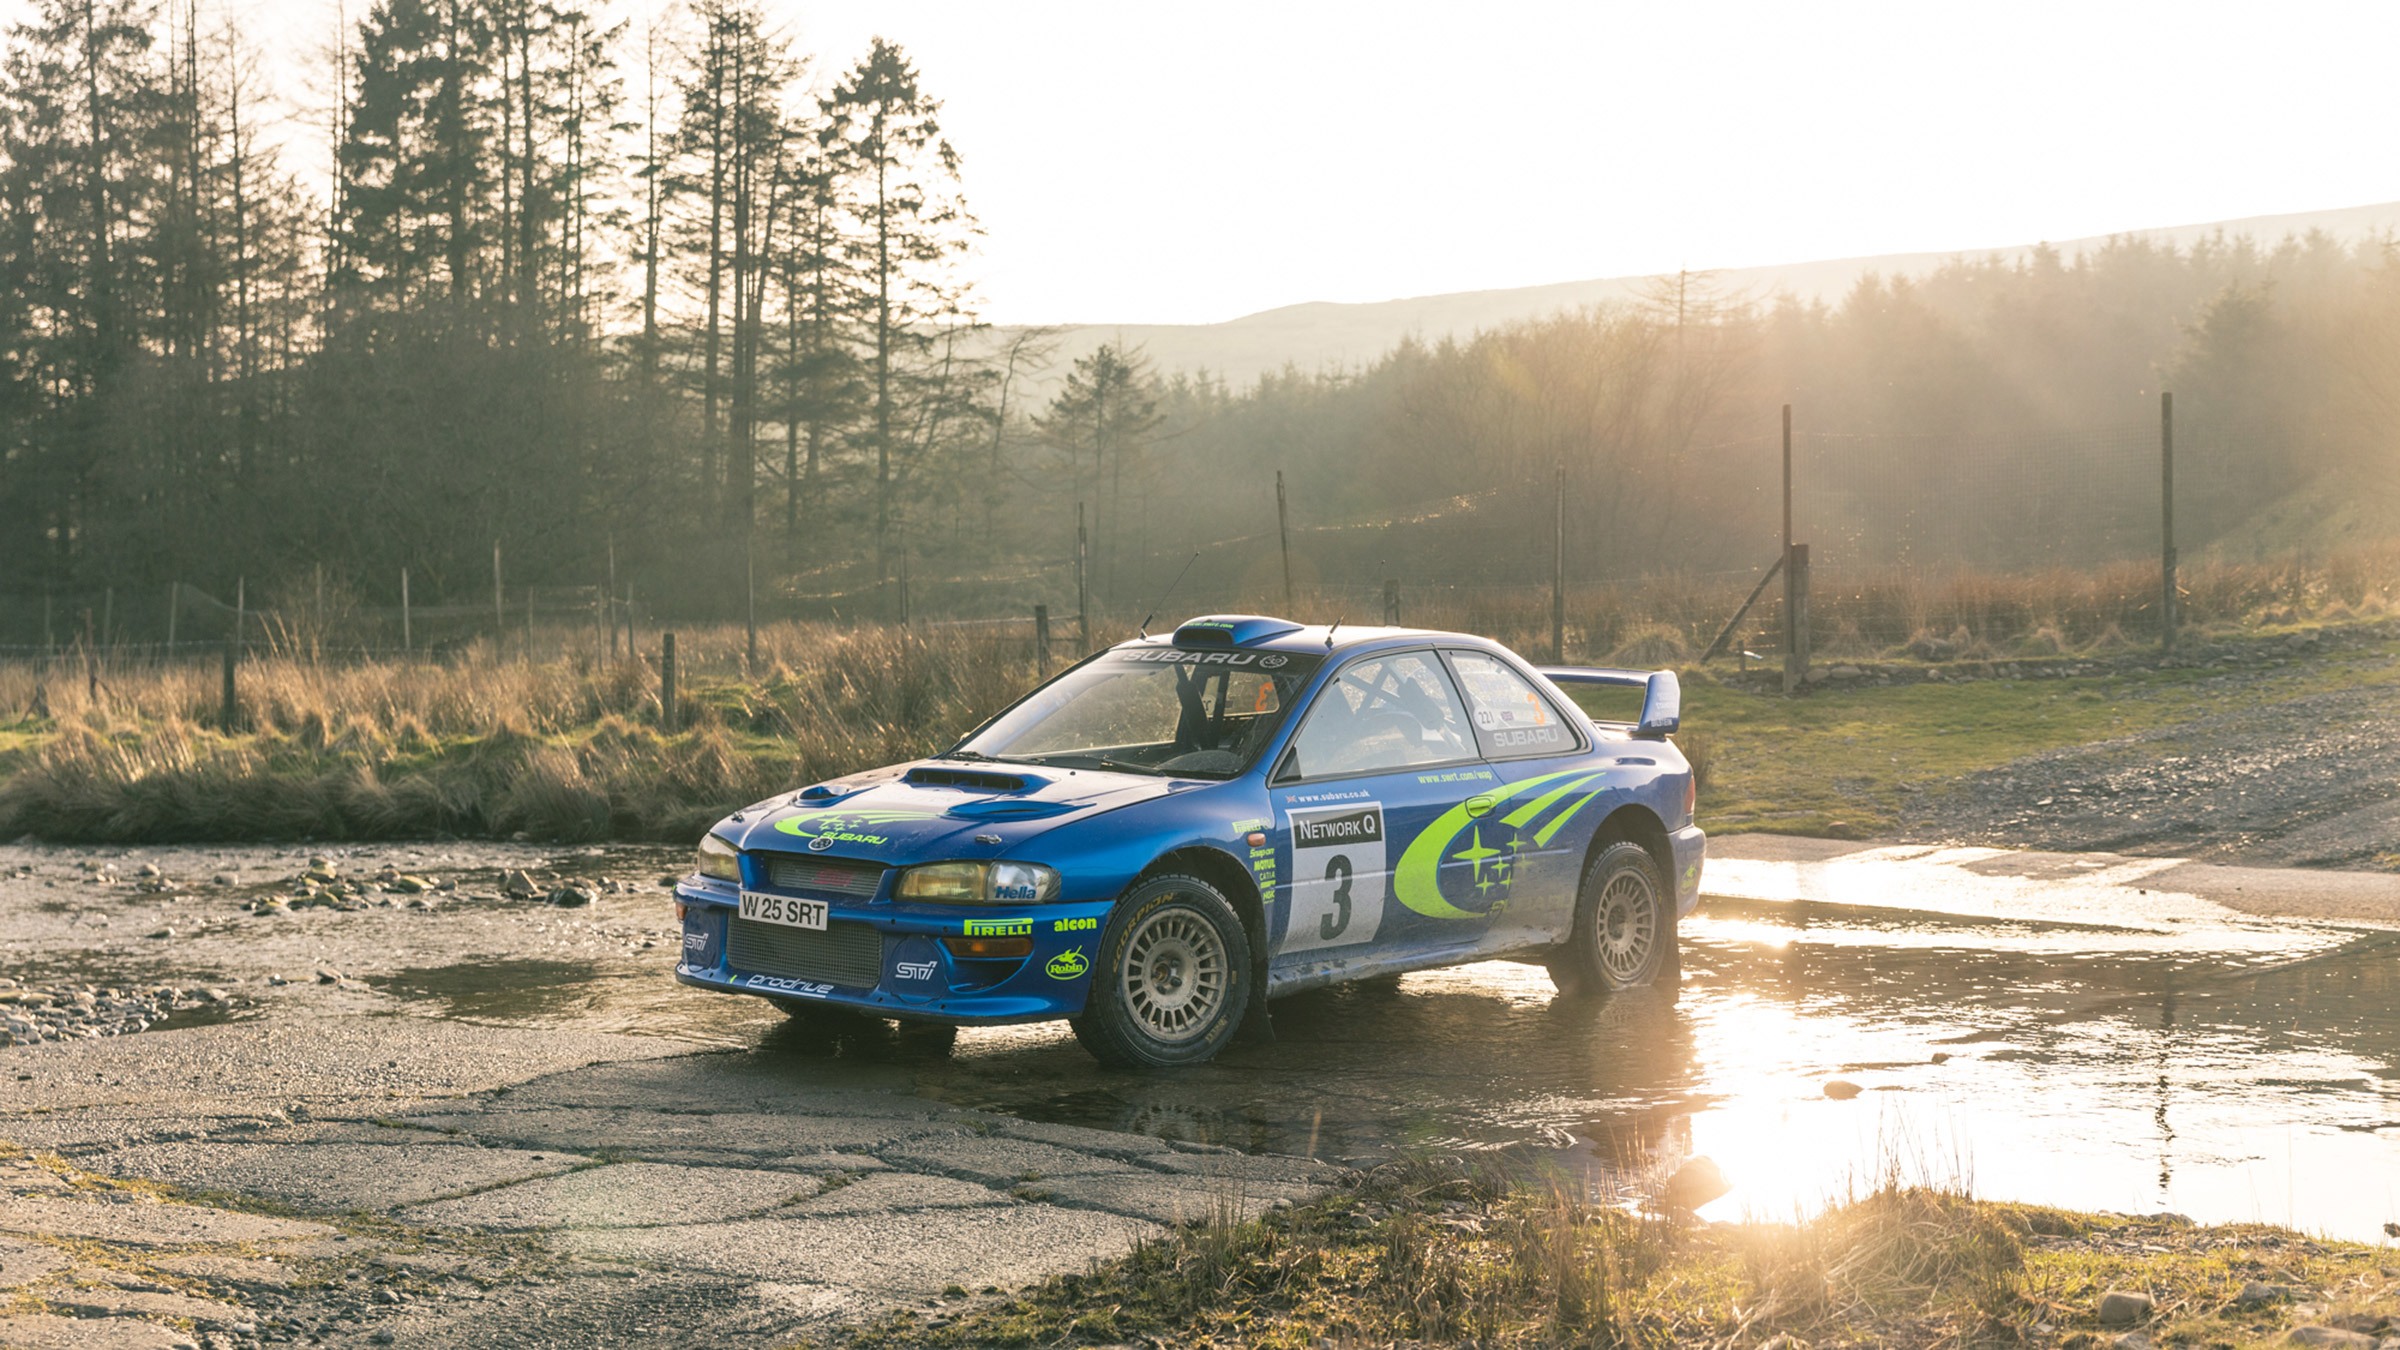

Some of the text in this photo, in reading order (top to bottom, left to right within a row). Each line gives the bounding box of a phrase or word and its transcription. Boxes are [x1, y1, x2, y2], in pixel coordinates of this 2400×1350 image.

[1123, 650, 1256, 665] SUBARU
[1527, 692, 1545, 726] 3
[1493, 729, 1558, 748] SUBARU
[1417, 770, 1493, 784] www.swrt.com/wap
[1297, 789, 1370, 802] www.subaru.co.uk
[1363, 814, 1376, 834] Q
[821, 831, 888, 844] SUBARU
[1254, 858, 1276, 871] MOTUL
[995, 886, 1036, 900] Hella
[1320, 854, 1353, 940] 3
[743, 895, 825, 926] W 25 SRT
[964, 918, 1034, 936] PIRELLI
[1054, 917, 1097, 932] alcon
[1050, 961, 1083, 974] Robin
[746, 974, 835, 995] prodrive
